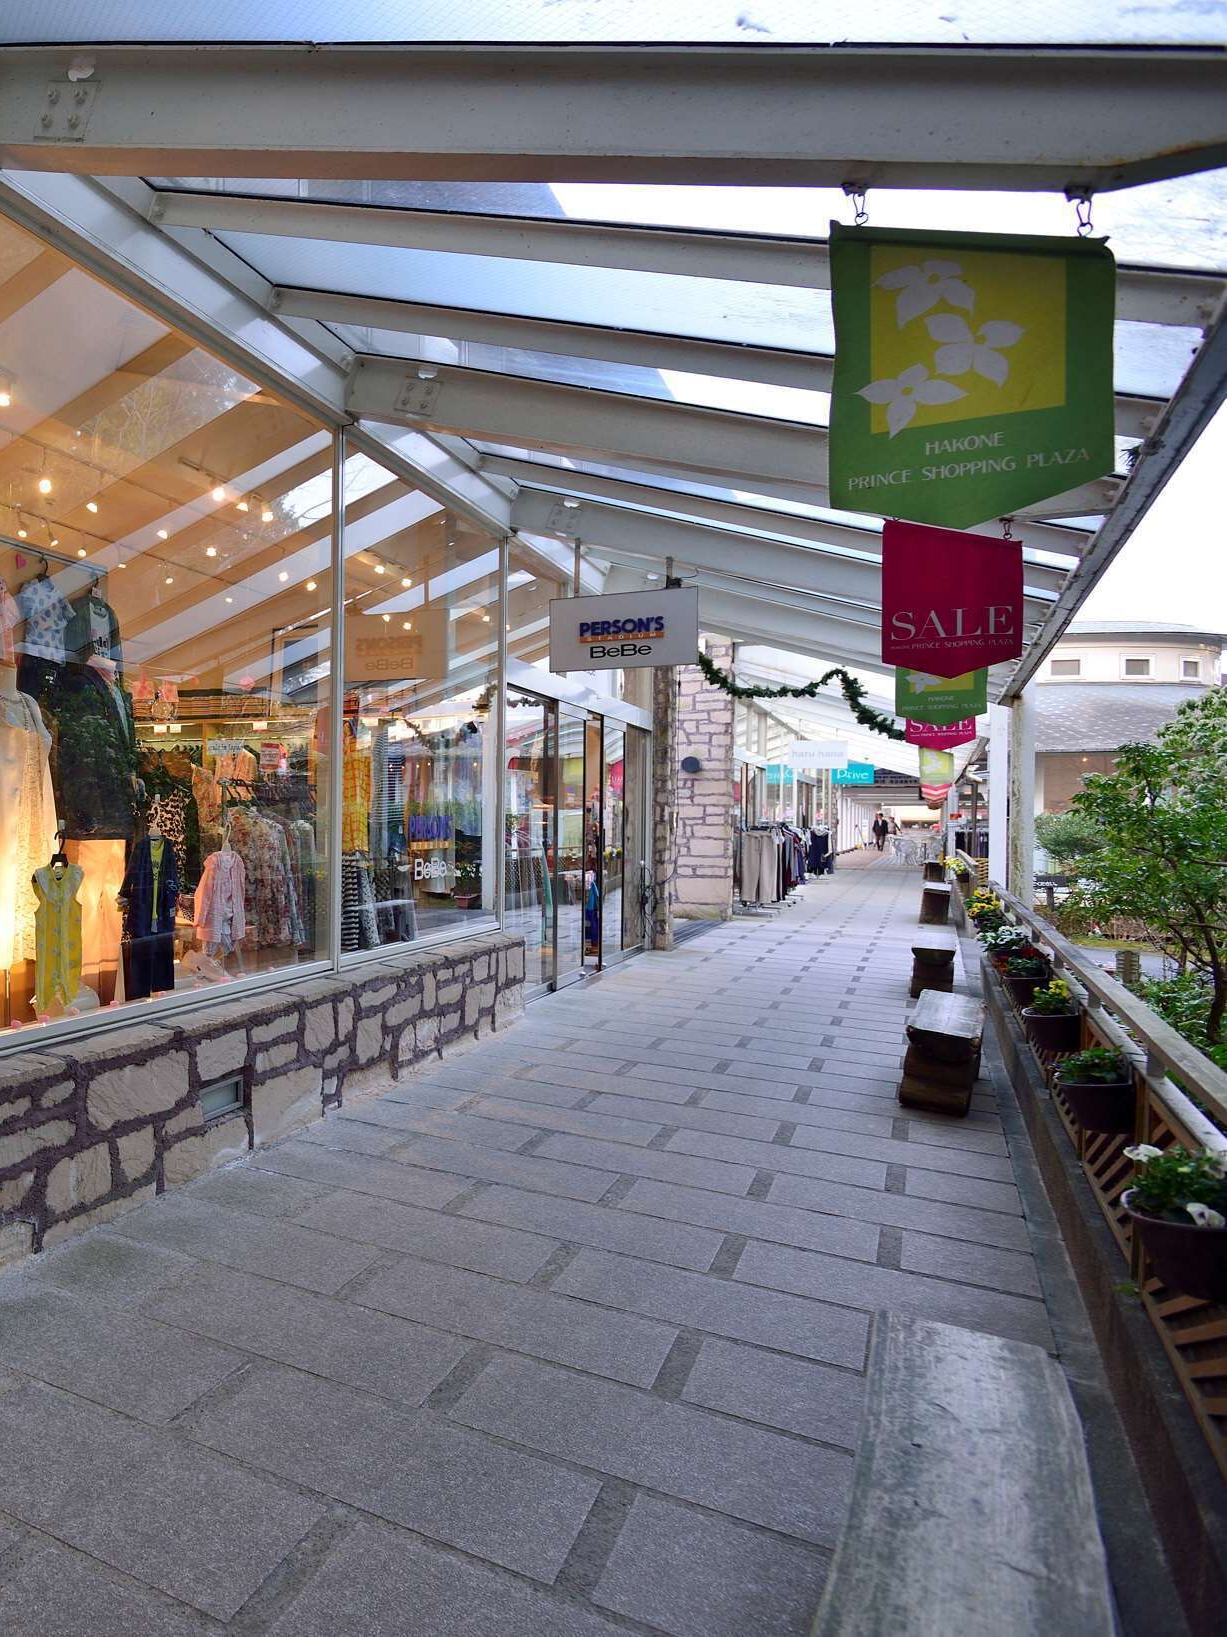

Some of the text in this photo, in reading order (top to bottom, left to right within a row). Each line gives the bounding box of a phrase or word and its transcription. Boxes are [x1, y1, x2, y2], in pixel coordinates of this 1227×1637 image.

[925, 432, 1005, 455] HAKONE
[848, 448, 1090, 490] PRINCE SHOPPING PLAZA
[579, 616, 664, 636] PERSON'S
[891, 606, 1014, 641] SALE
[590, 643, 652, 659] BeBe
[911, 642, 941, 650] PRINCE
[944, 639, 984, 649] SHOPPING
[988, 638, 1014, 646] PLAZA
[414, 857, 447, 881] BeBe
